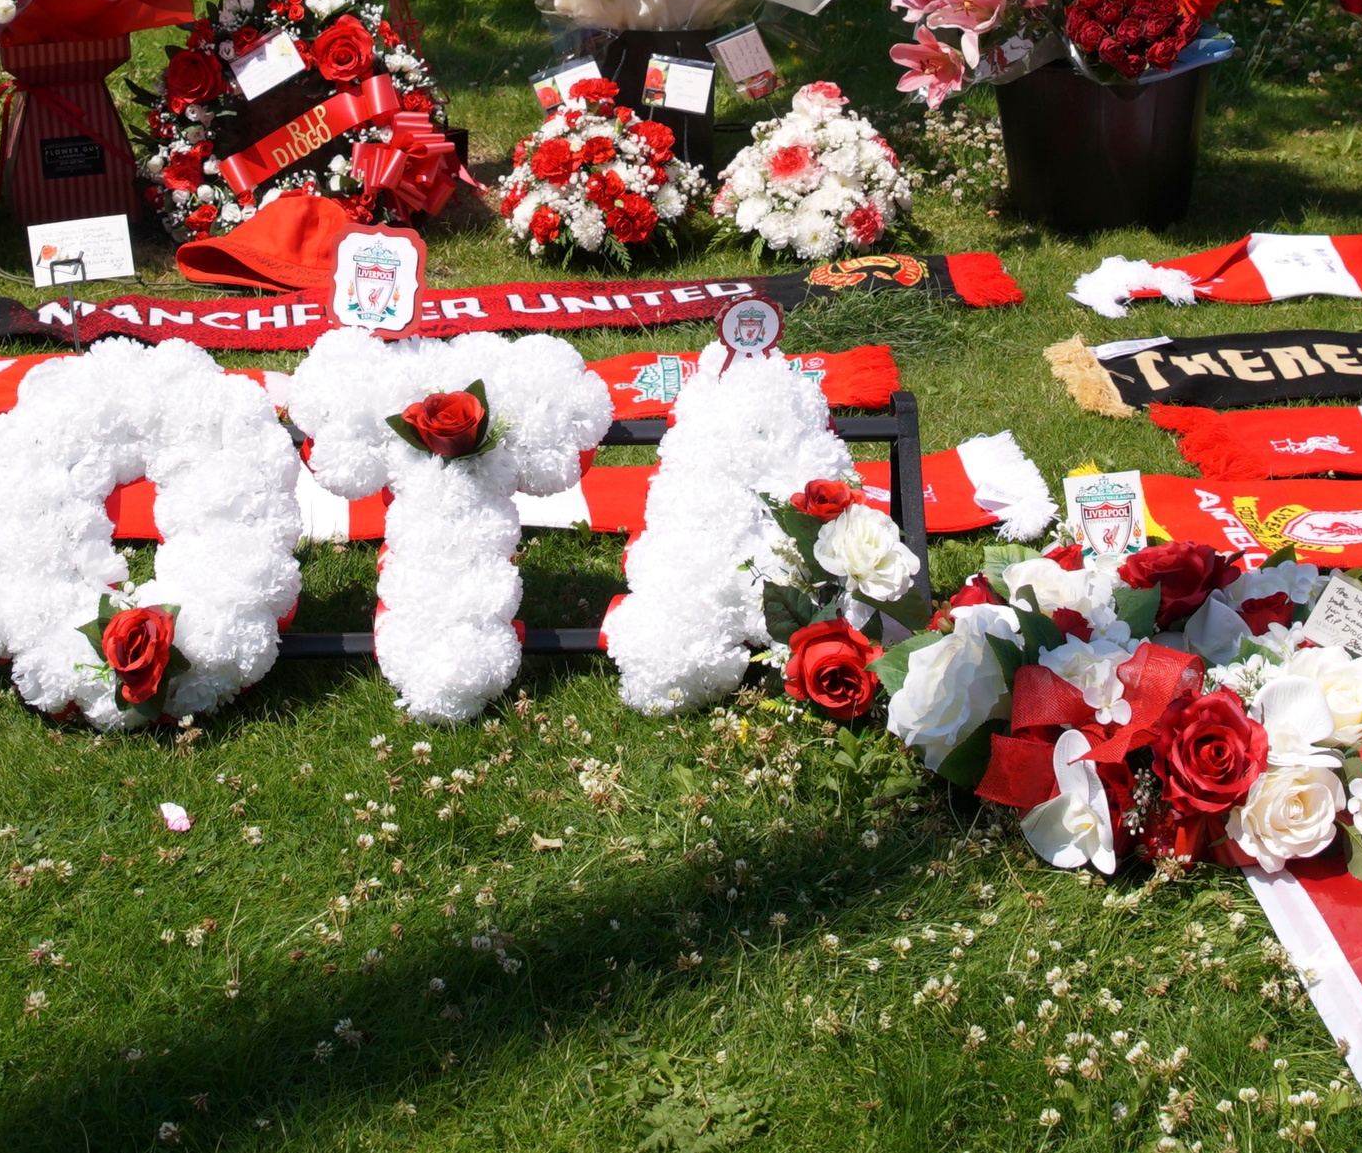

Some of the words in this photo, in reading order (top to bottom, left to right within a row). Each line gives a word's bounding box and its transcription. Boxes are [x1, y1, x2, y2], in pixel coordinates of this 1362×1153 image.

[286, 105, 327, 141] RIP
[45, 148, 79, 156] FLOWER
[272, 123, 332, 168] DIOGO
[358, 269, 394, 280] LIVERPOOL
[38, 296, 488, 331] MANCHEER
[507, 282, 753, 314] UNITED
[1085, 508, 1129, 519] LIVERPOOL
[1194, 488, 1269, 570] ANFIELD
